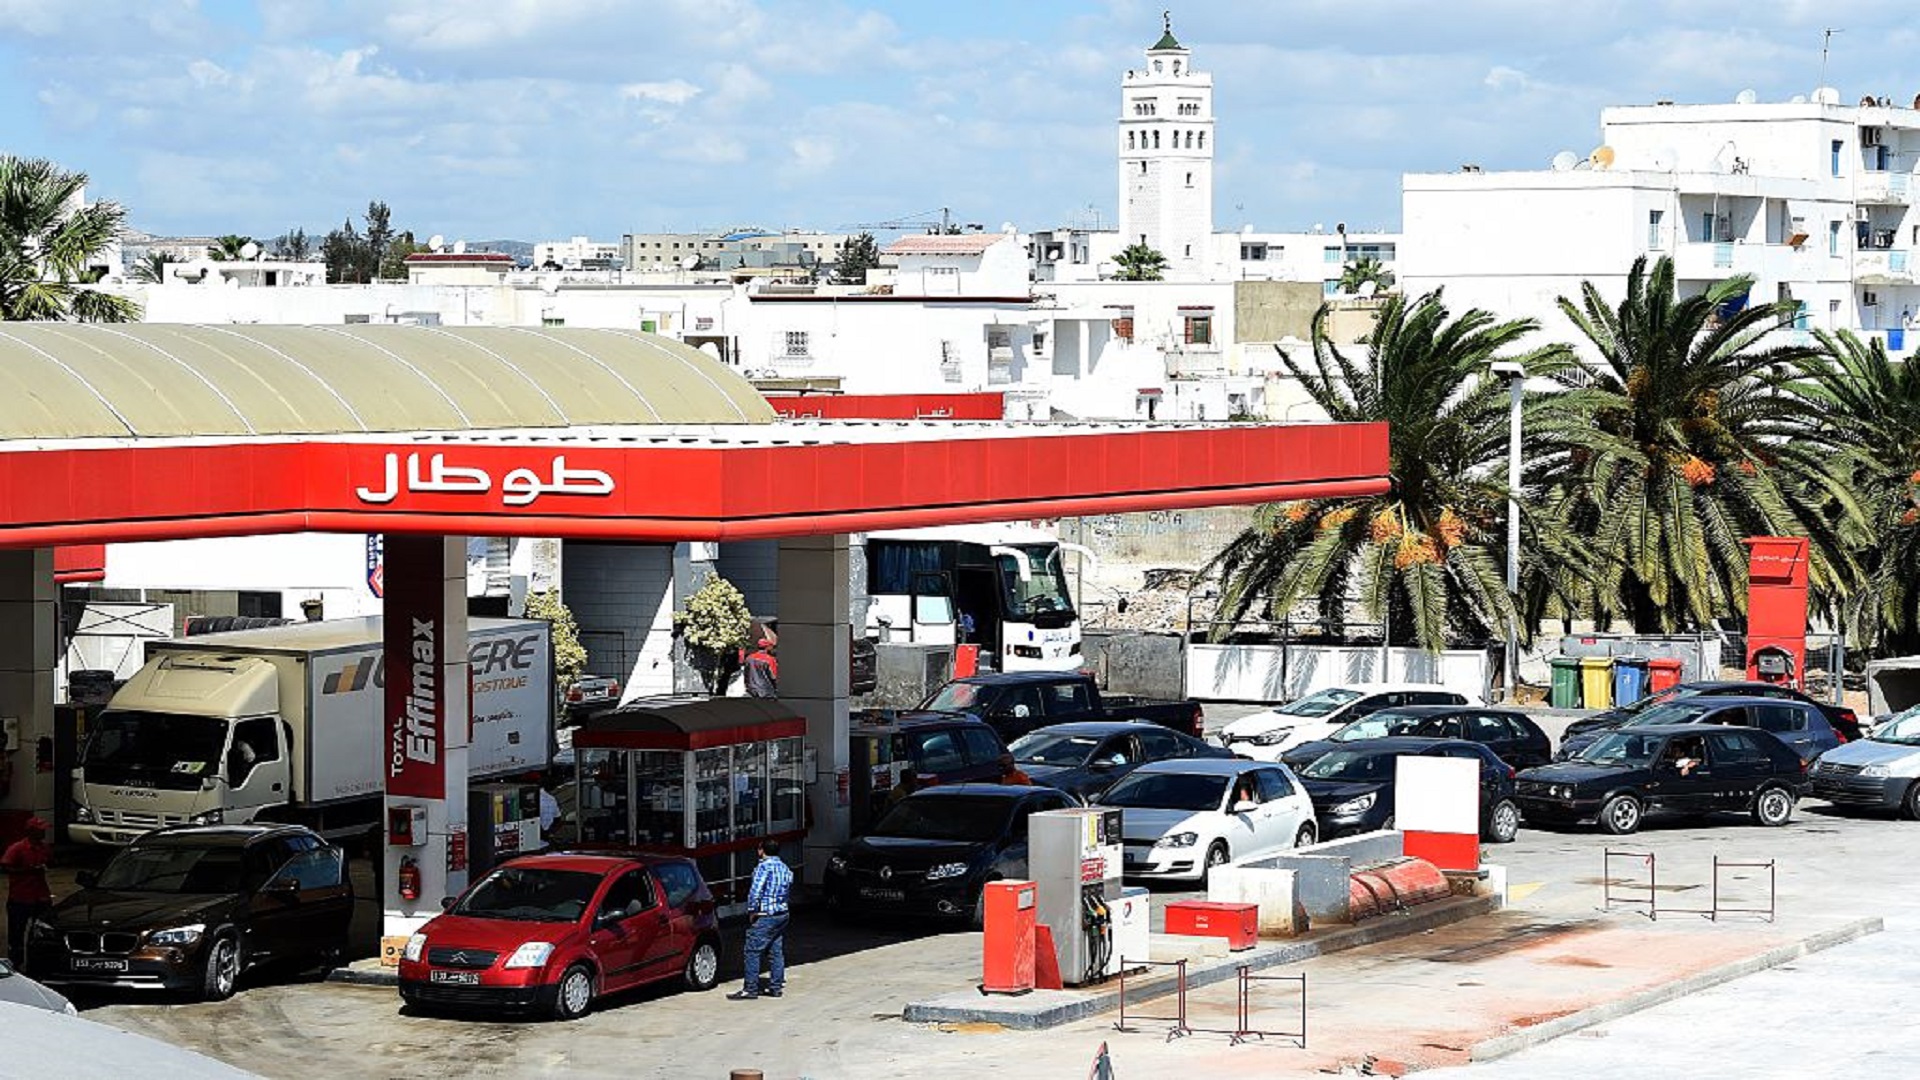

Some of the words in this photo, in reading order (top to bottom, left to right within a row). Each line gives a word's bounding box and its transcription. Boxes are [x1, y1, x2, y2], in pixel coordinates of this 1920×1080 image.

[355, 452, 615, 506] طوطال
[406, 617, 436, 765] Effimax
[391, 717, 404, 778] TOTAL
